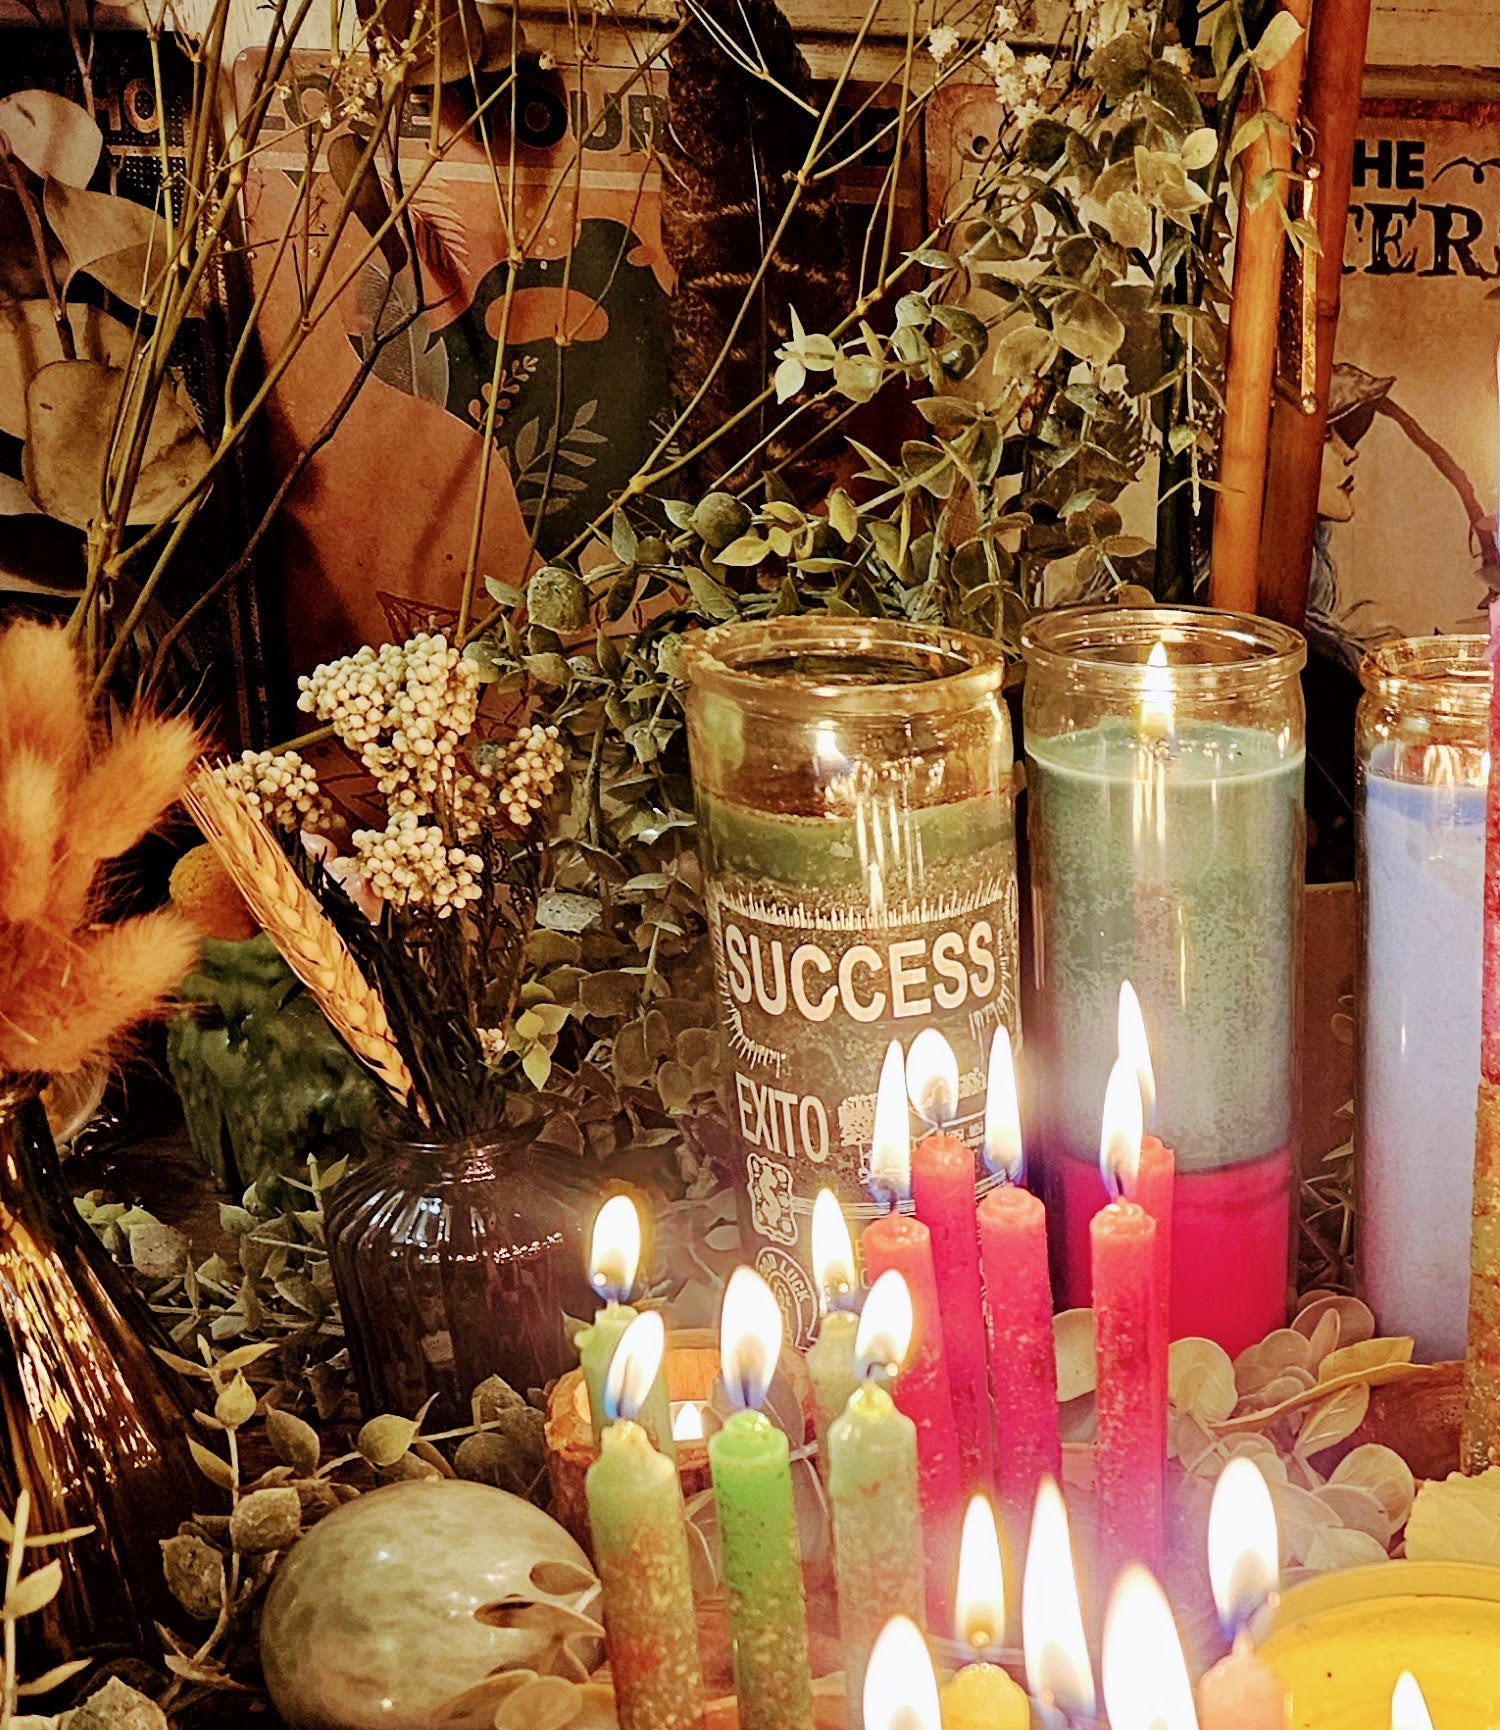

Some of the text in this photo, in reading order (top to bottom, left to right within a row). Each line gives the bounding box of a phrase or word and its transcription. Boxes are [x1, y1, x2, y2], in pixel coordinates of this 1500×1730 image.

[1352, 139, 1425, 190] HE
[724, 920, 997, 1023] SUCCESS
[735, 1071, 830, 1163] EXITO
[779, 1258, 811, 1303] LUCK
